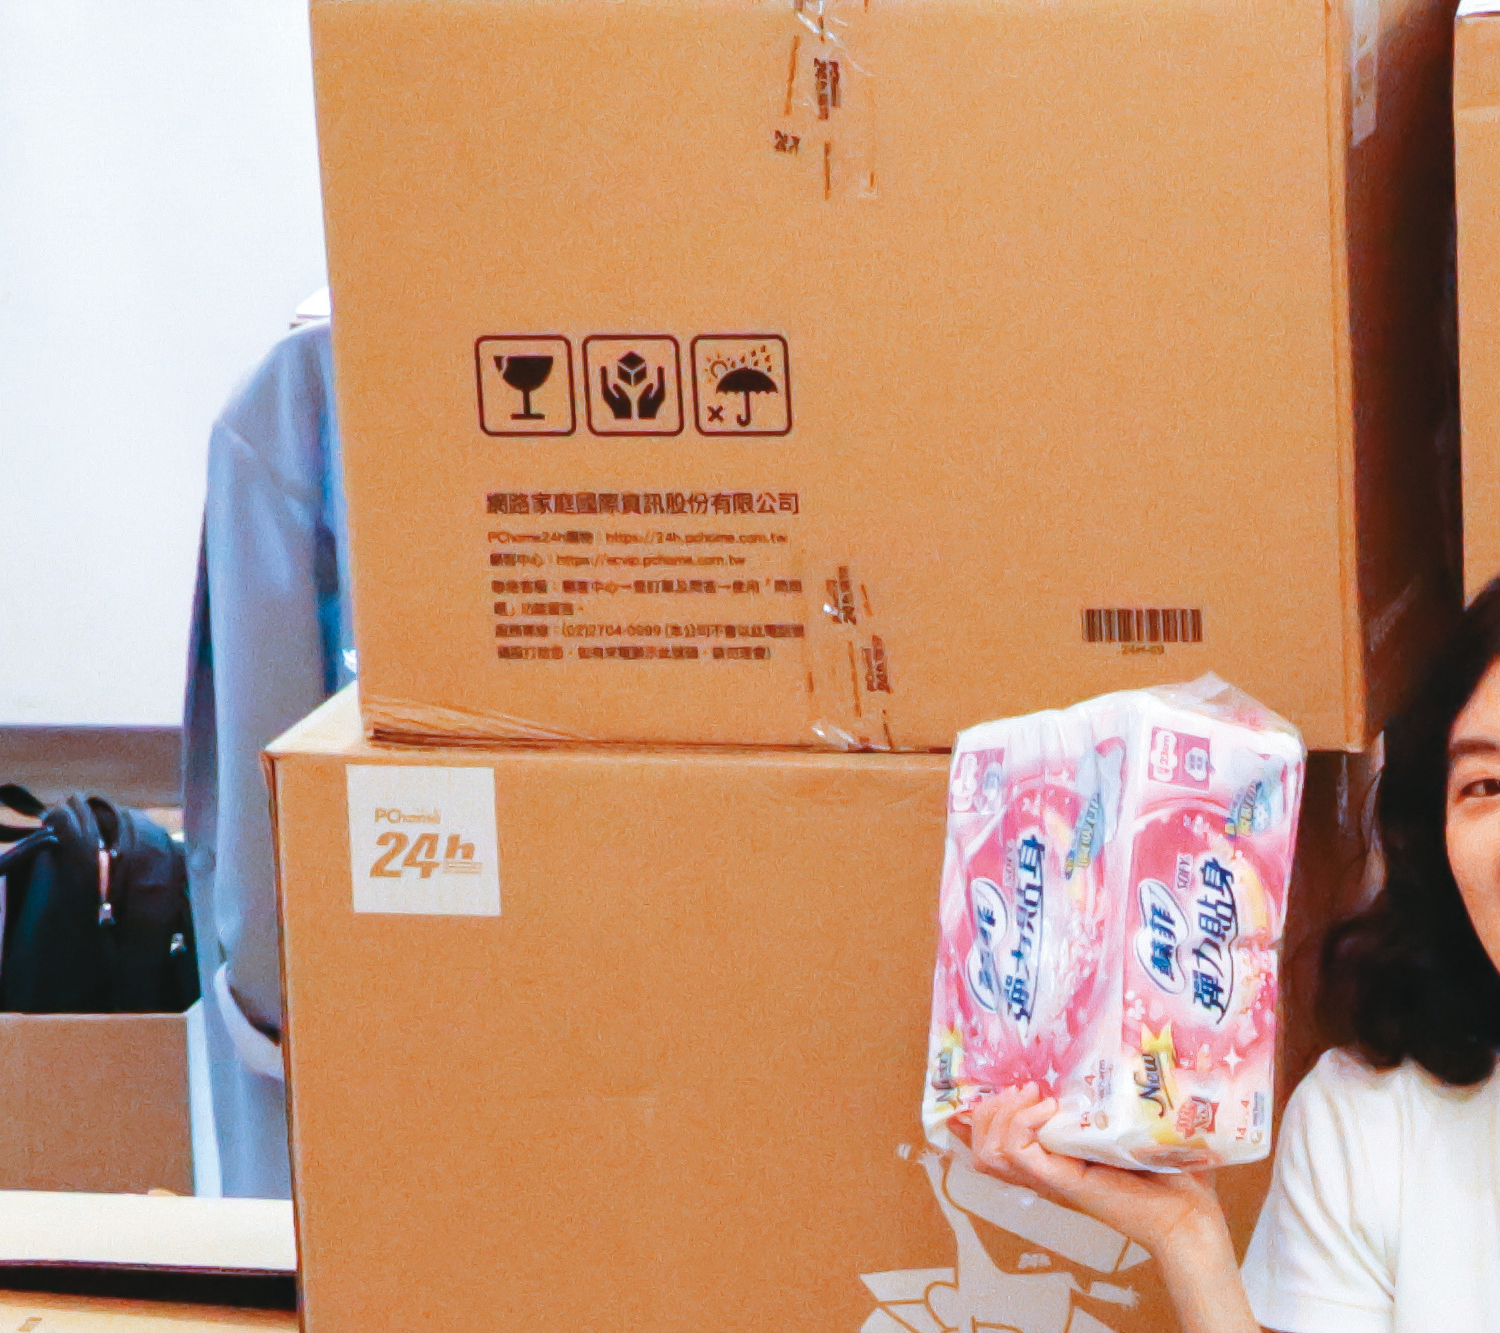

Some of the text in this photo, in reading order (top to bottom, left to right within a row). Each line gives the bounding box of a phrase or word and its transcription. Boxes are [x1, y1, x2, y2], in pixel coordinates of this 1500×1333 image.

[370, 831, 476, 879] 24h
[1193, 857, 1238, 1024] 彈力貼身
[1134, 1050, 1173, 1117] New
